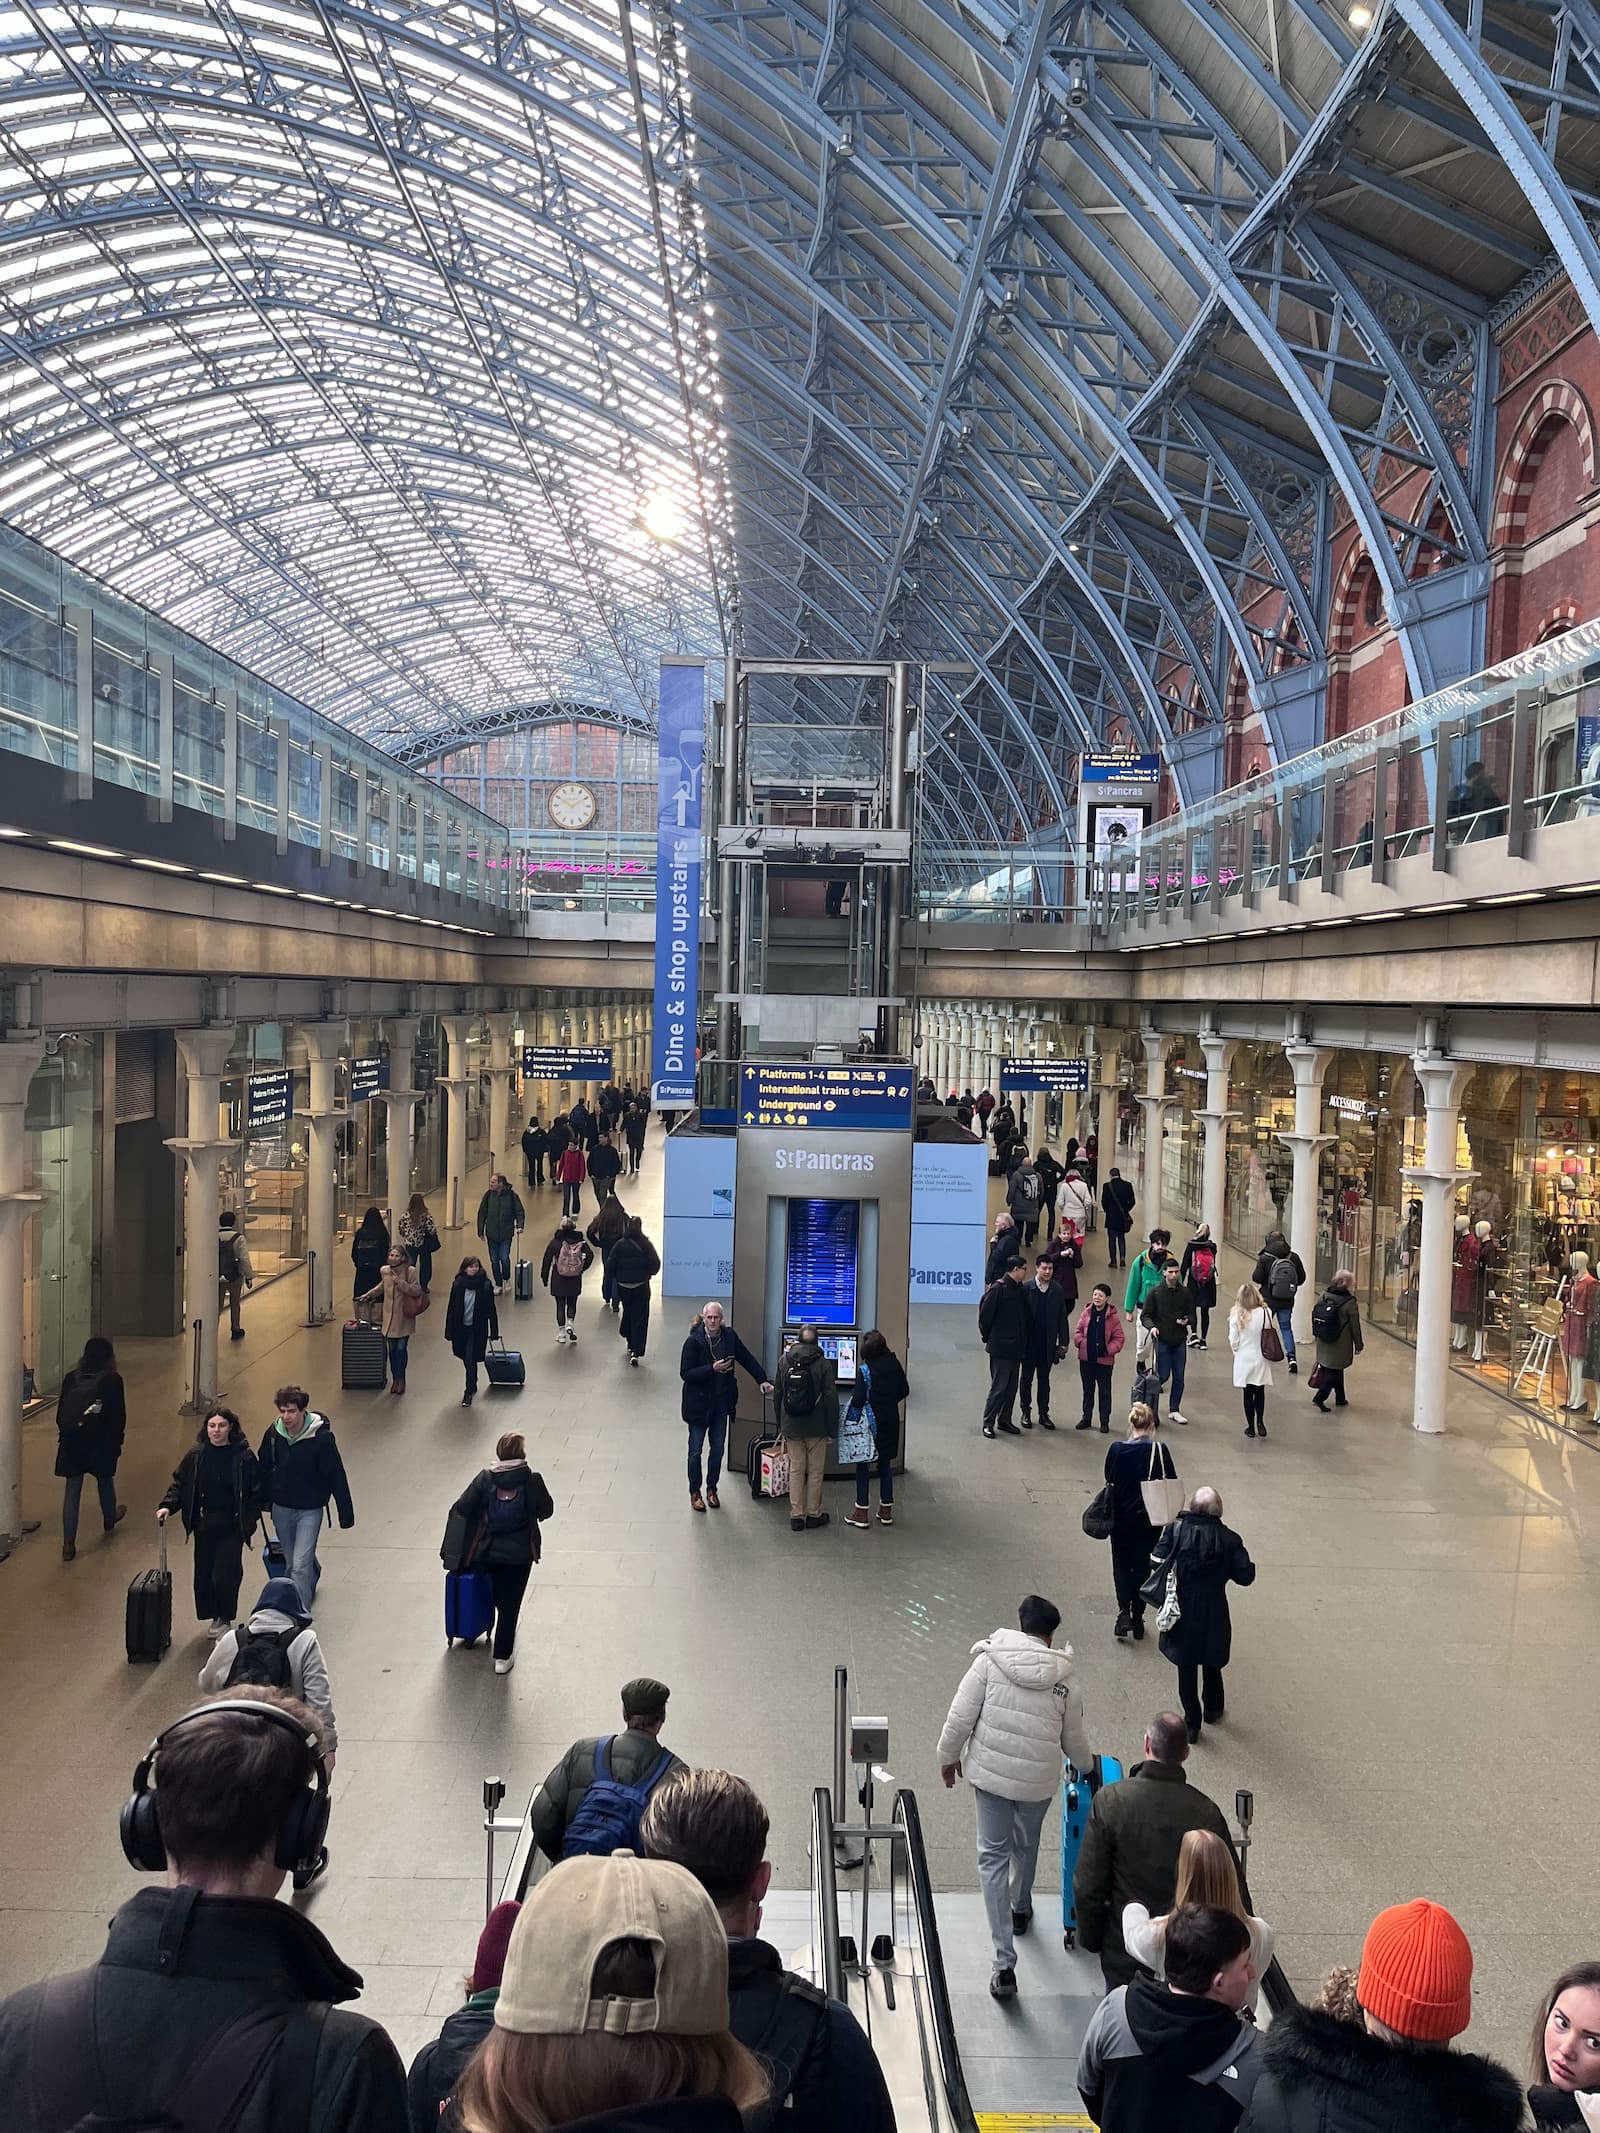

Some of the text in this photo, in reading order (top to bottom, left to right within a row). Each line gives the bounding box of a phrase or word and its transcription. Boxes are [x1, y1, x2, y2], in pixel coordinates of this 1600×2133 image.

[664, 840, 692, 1072] Dine & shop upstairs
[759, 1069, 806, 1080] Platforms
[809, 1071, 825, 1080] 1-4
[759, 1084, 820, 1095] International
[822, 1086, 850, 1096] trains
[759, 1099, 821, 1112] Underground
[1328, 1095, 1366, 1113] ACCESSORIZE
[796, 1150, 874, 1171] Pancras
